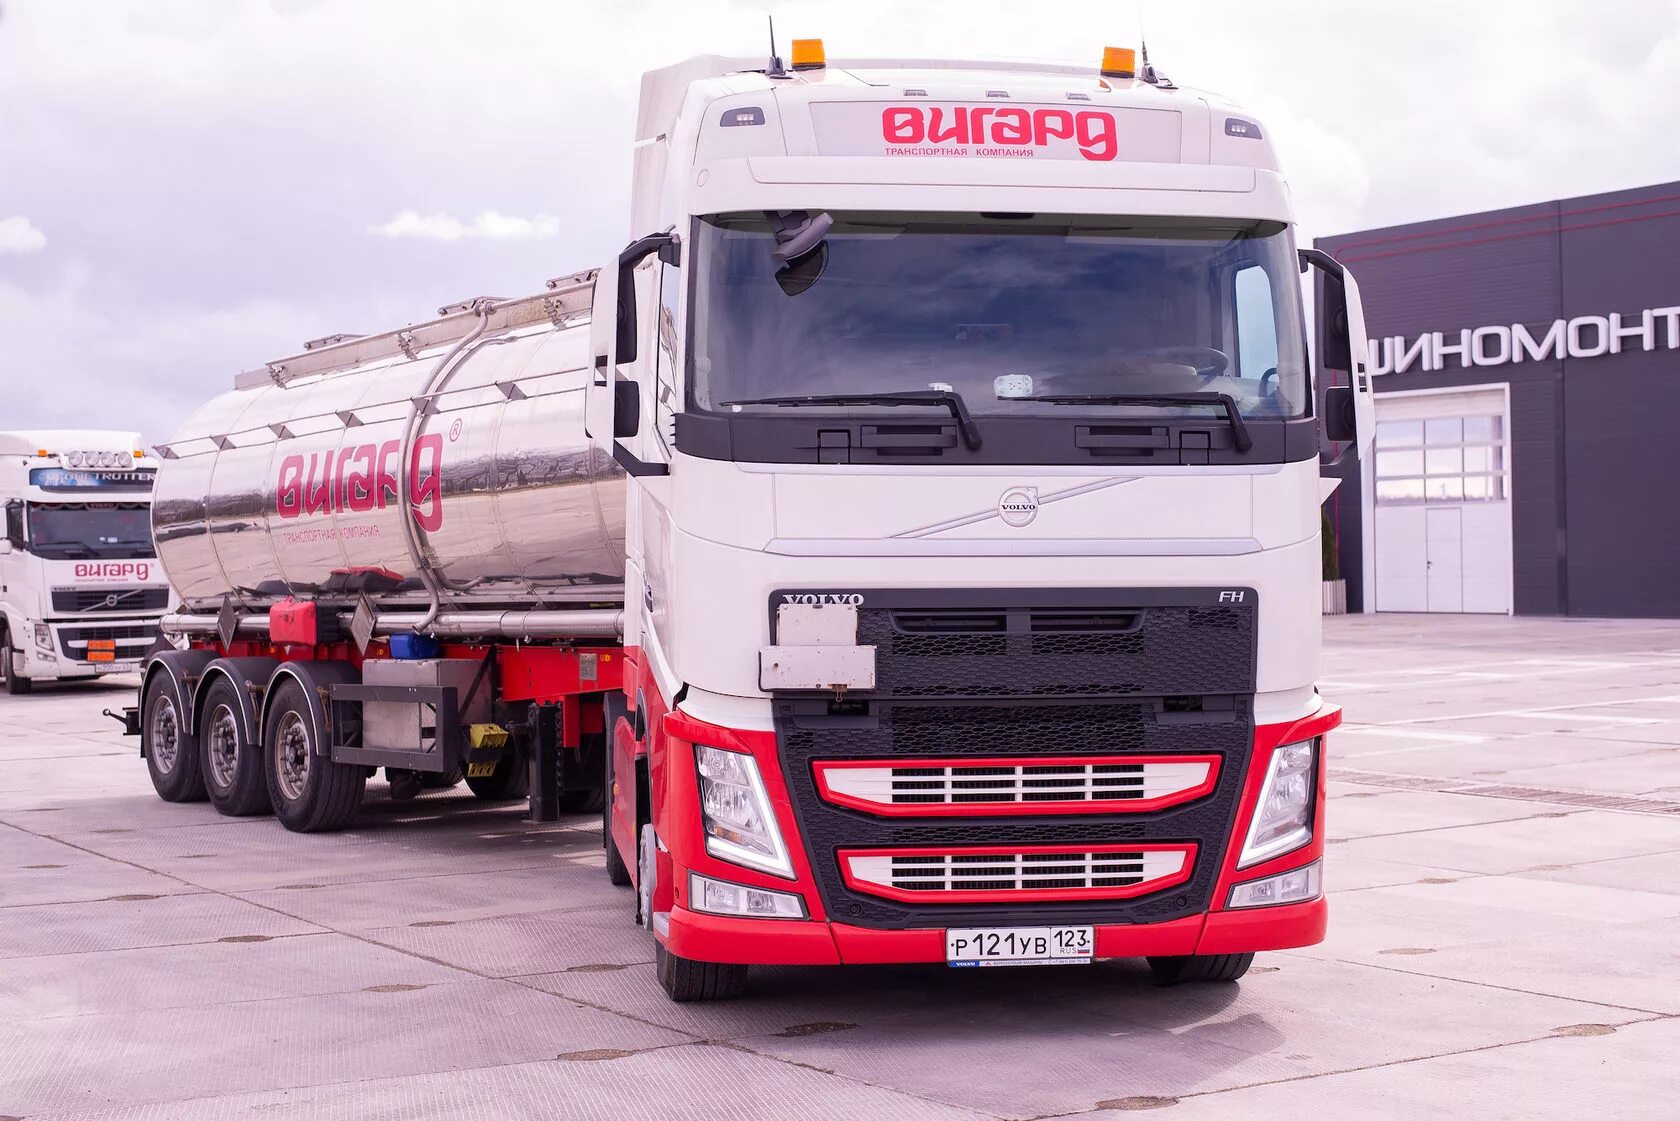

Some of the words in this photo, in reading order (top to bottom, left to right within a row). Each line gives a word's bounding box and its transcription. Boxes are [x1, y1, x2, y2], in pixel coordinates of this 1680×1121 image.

[885, 147, 968, 156] ТРАНСПОРТНАЯ
[976, 148, 1034, 157] КОМПАНИЯ
[283, 527, 337, 545] ТРАНСПОРТНАЯ
[339, 524, 381, 541] КОМПАНИЯ
[783, 593, 864, 606] VOLVO
[1218, 591, 1244, 602] FH
[1054, 930, 1087, 947] 123
